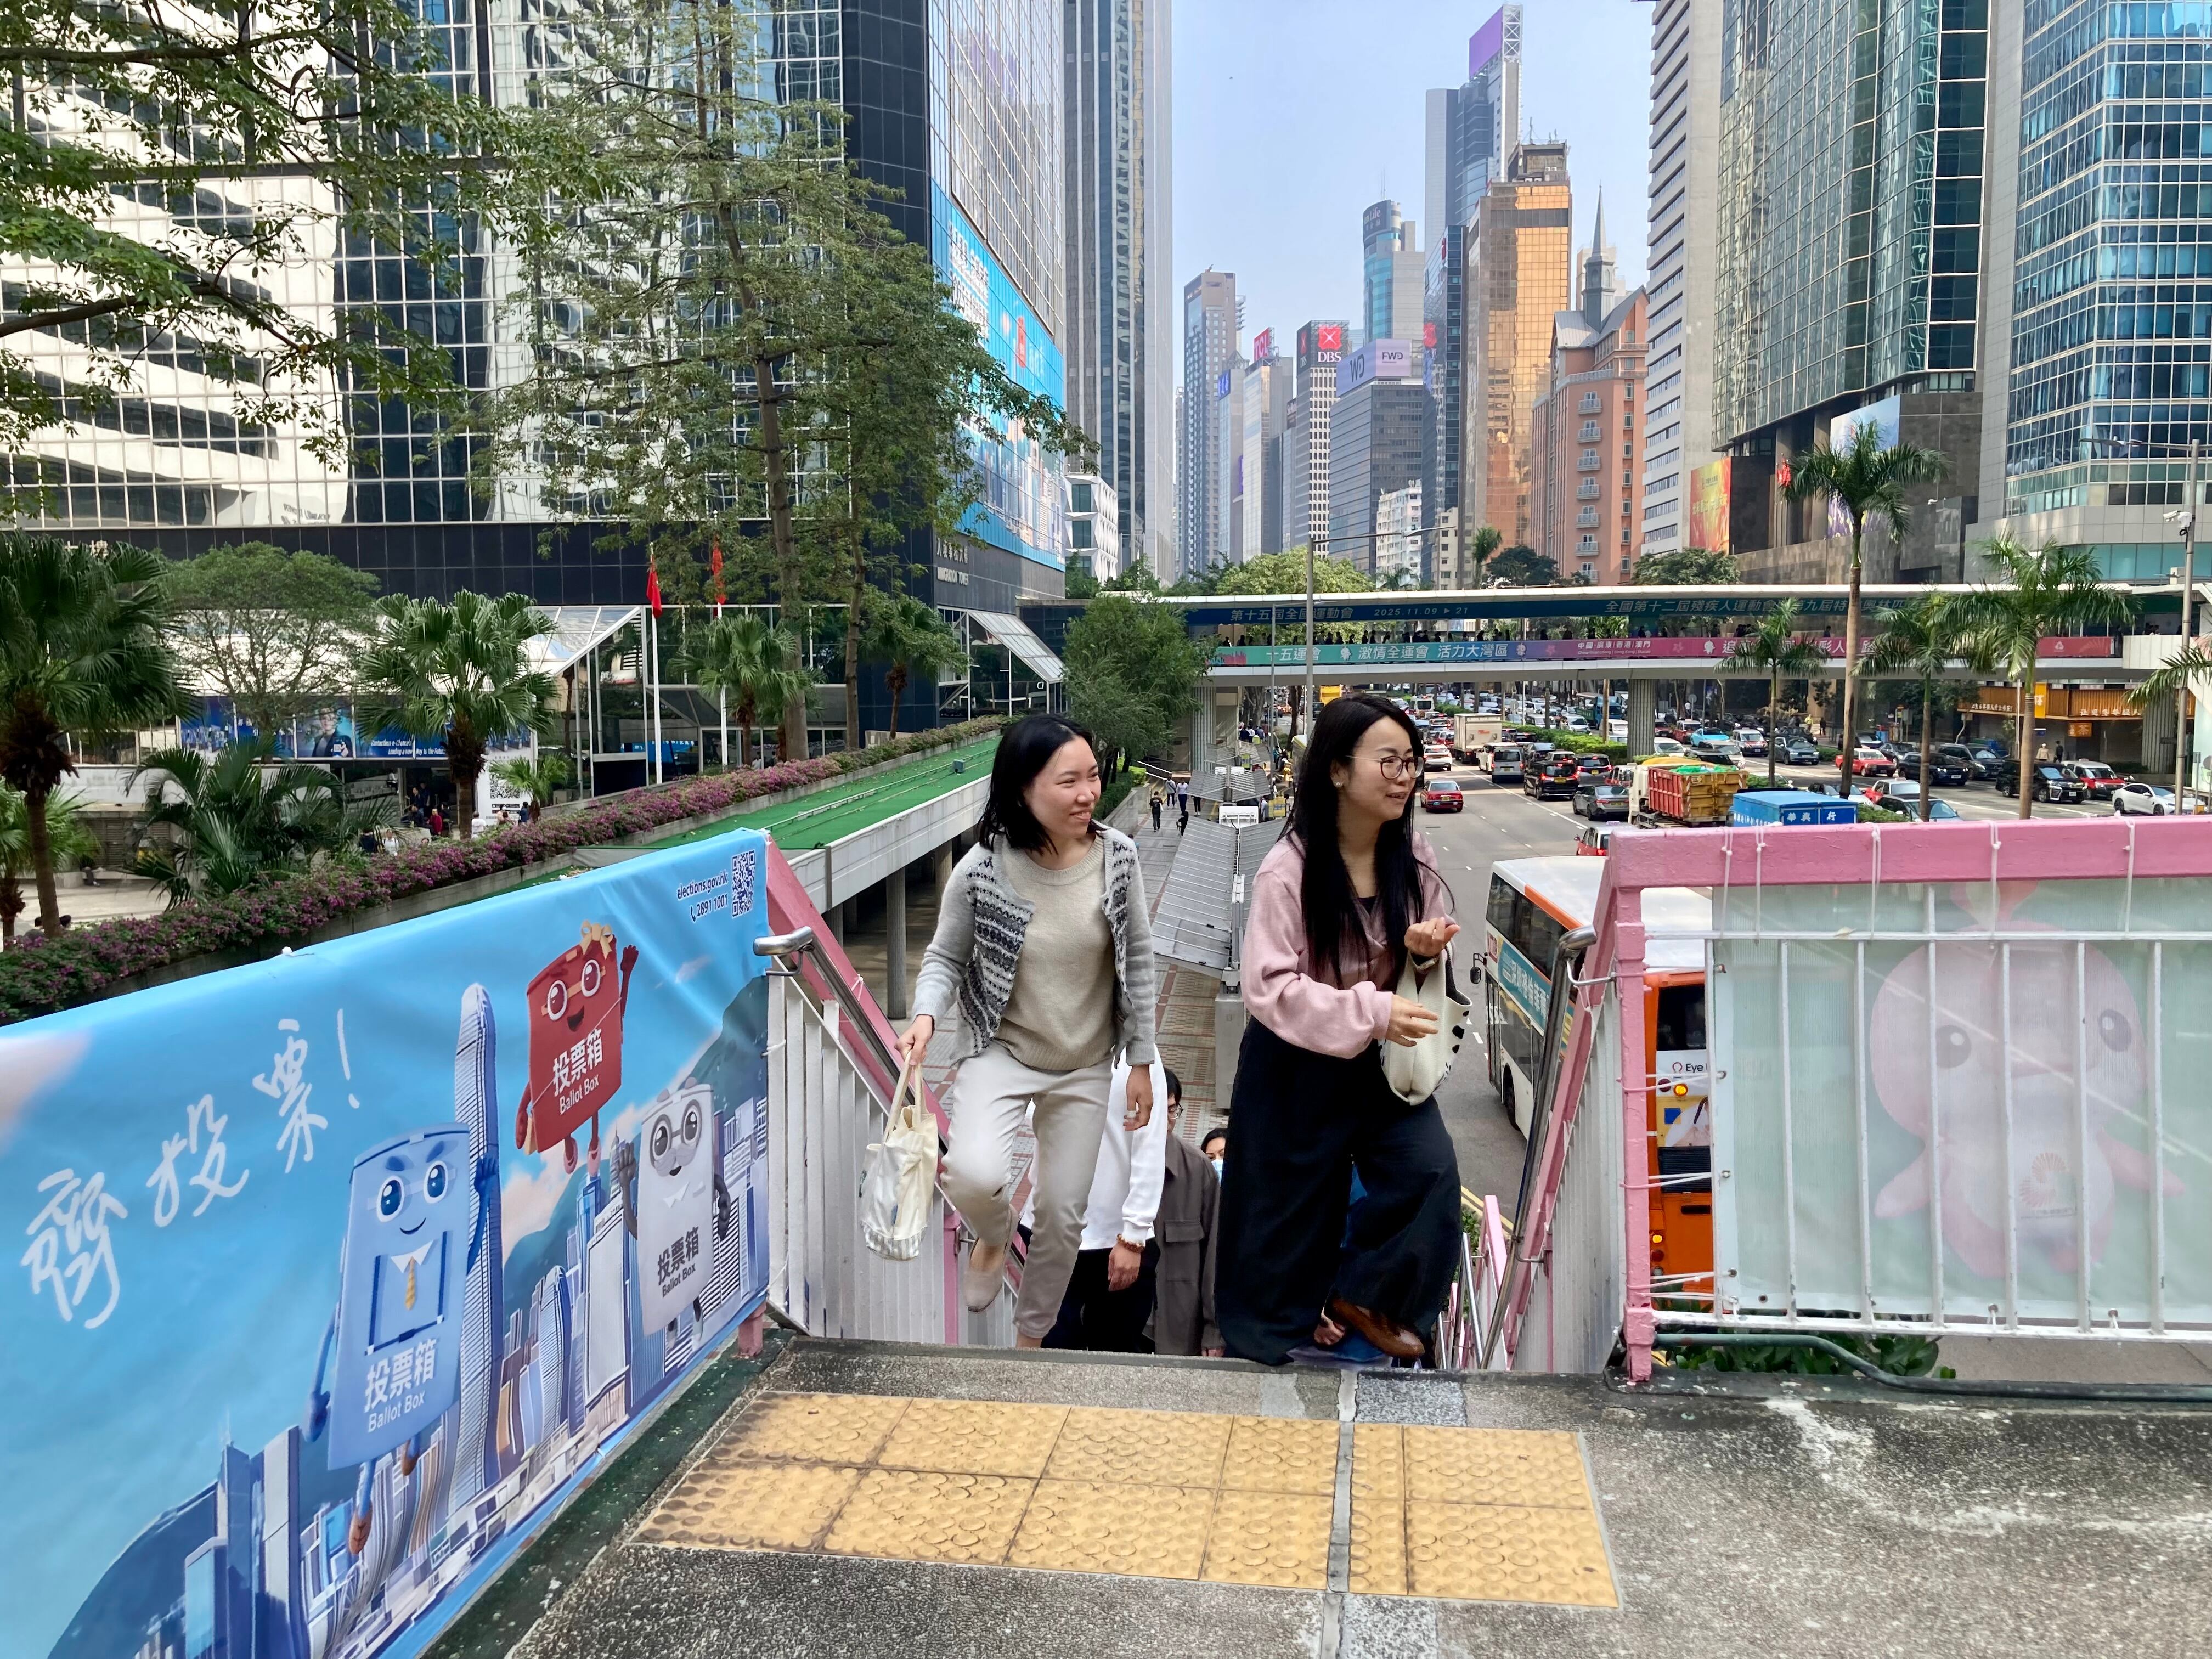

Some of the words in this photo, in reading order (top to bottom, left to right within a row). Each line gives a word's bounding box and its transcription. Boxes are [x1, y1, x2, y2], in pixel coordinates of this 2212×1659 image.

[1255, 334, 1268, 362] TCL
[1318, 351, 1342, 363] DBS
[1382, 352, 1403, 360] FWD
[1374, 607, 1437, 616] 2025.11.09
[1358, 645, 1429, 659] 激情全運會
[1437, 643, 1508, 658] 活力大灣區
[677, 869, 728, 899] elections.gov.hk
[697, 899, 712, 917] 2891
[714, 894, 727, 909] 1001
[552, 1029, 603, 1096] 投票箱
[1685, 1063, 1703, 1073] Eye
[559, 1085, 583, 1115] Ballot
[584, 1074, 600, 1099] Box
[657, 1226, 699, 1285] 投票箱
[662, 1275, 681, 1298] Ballot
[682, 1263, 696, 1284] Box
[364, 1339, 437, 1413] 投票箱
[368, 1401, 401, 1432] Ballot
[404, 1390, 425, 1413] Box
